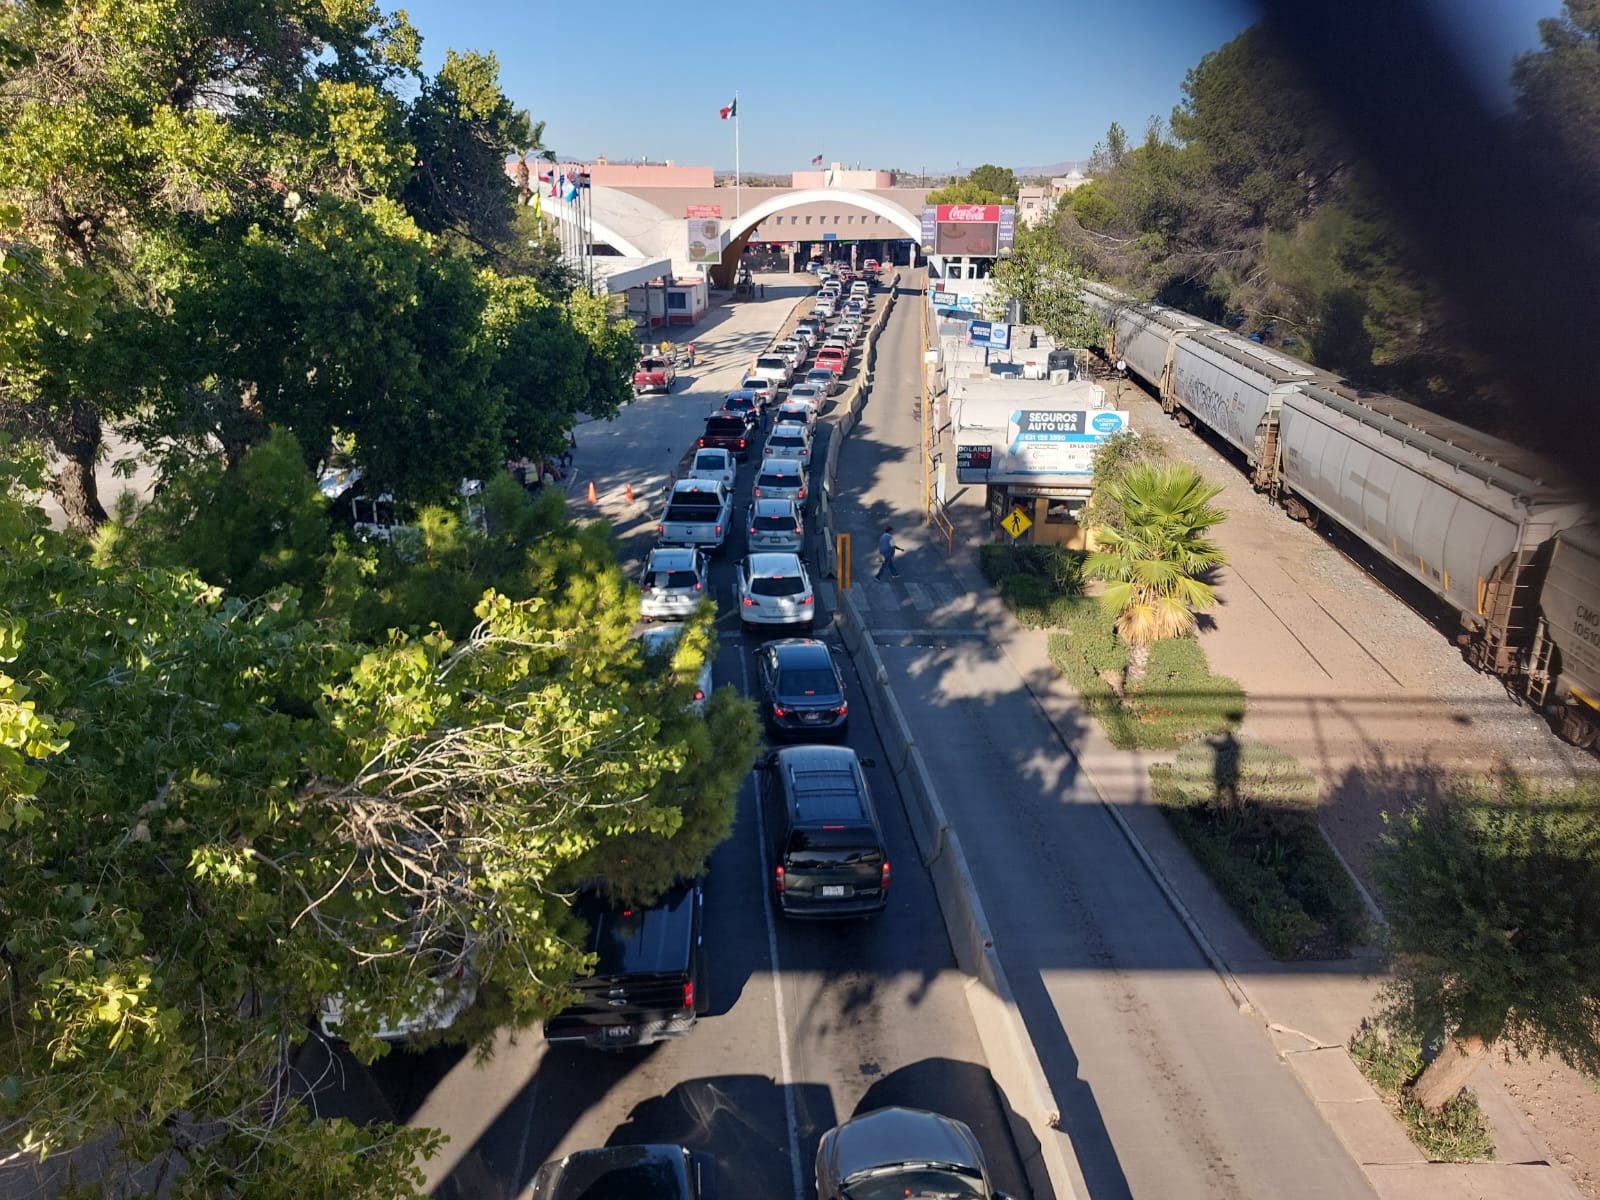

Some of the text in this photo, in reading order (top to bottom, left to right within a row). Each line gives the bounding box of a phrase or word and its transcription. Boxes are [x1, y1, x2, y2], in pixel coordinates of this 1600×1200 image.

[949, 206, 986, 220] Coca-Cola
[1029, 412, 1078, 422] SEGUROS
[1028, 423, 1077, 431] AUTO USA
[1576, 605, 1600, 627] CMO
[1573, 620, 1600, 650] 10510
